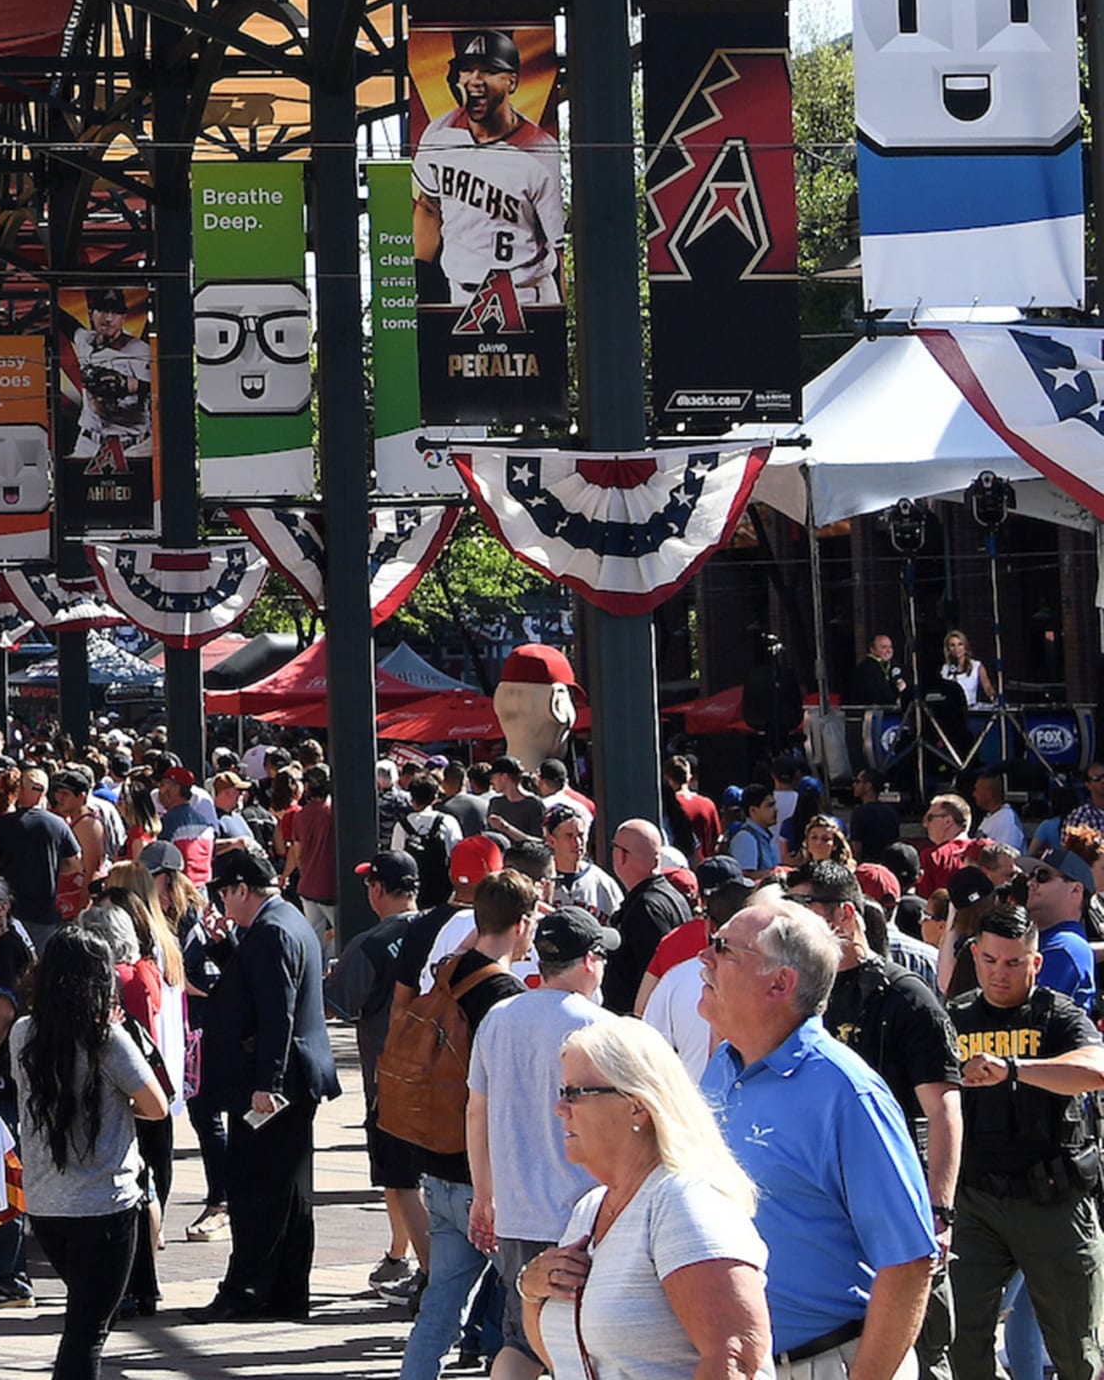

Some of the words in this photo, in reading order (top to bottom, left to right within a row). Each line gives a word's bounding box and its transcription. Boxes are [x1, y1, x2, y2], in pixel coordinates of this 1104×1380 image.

[203, 188, 284, 206] Breathe
[203, 213, 263, 233] Deep.
[495, 231, 514, 263] 6
[448, 354, 540, 378] PERALTA
[676, 395, 741, 407] dbacks.com
[86, 486, 133, 501] AHMED
[1036, 730, 1063, 744] FOX
[956, 1029, 1042, 1062] SHERIFF
